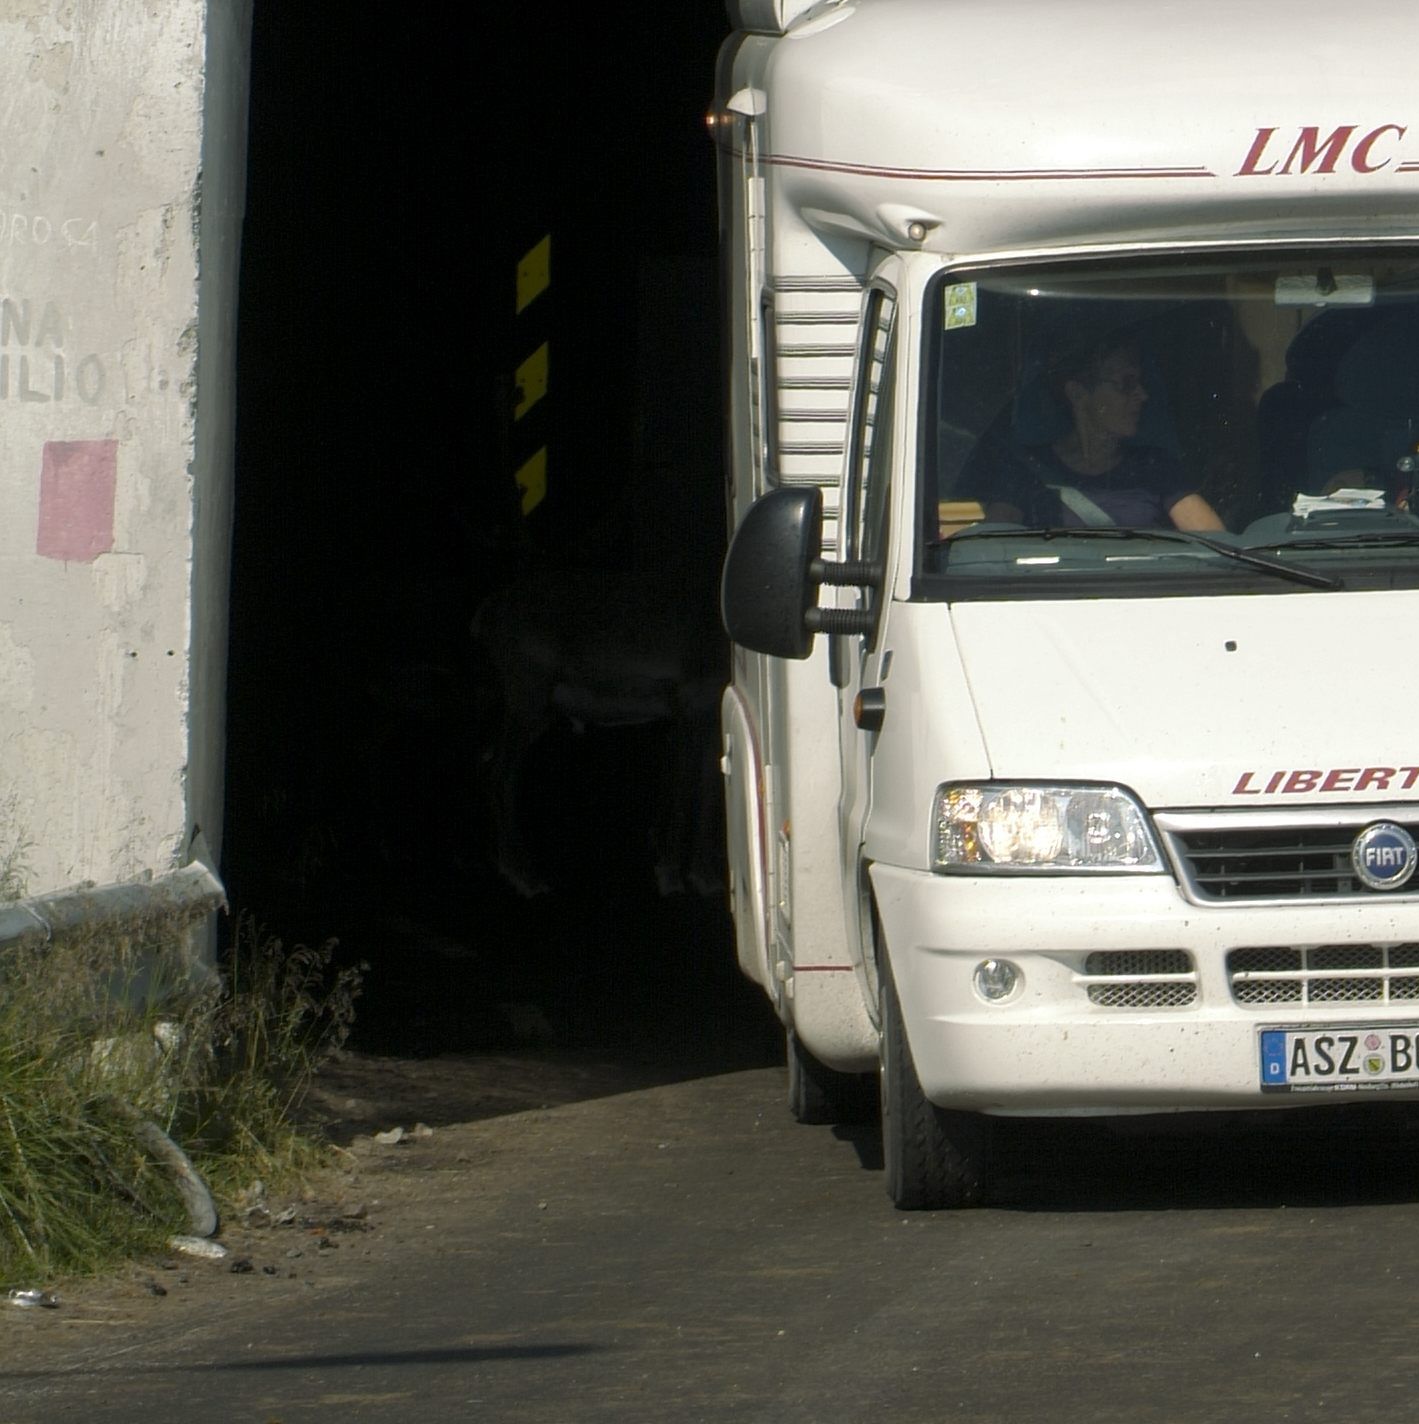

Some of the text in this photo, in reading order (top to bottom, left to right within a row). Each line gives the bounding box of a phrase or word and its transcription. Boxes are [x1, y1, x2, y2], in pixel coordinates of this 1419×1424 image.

[1232, 123, 1408, 177] LMC
[1364, 846, 1405, 868] FIAT
[1289, 1034, 1361, 1077] ASZ
